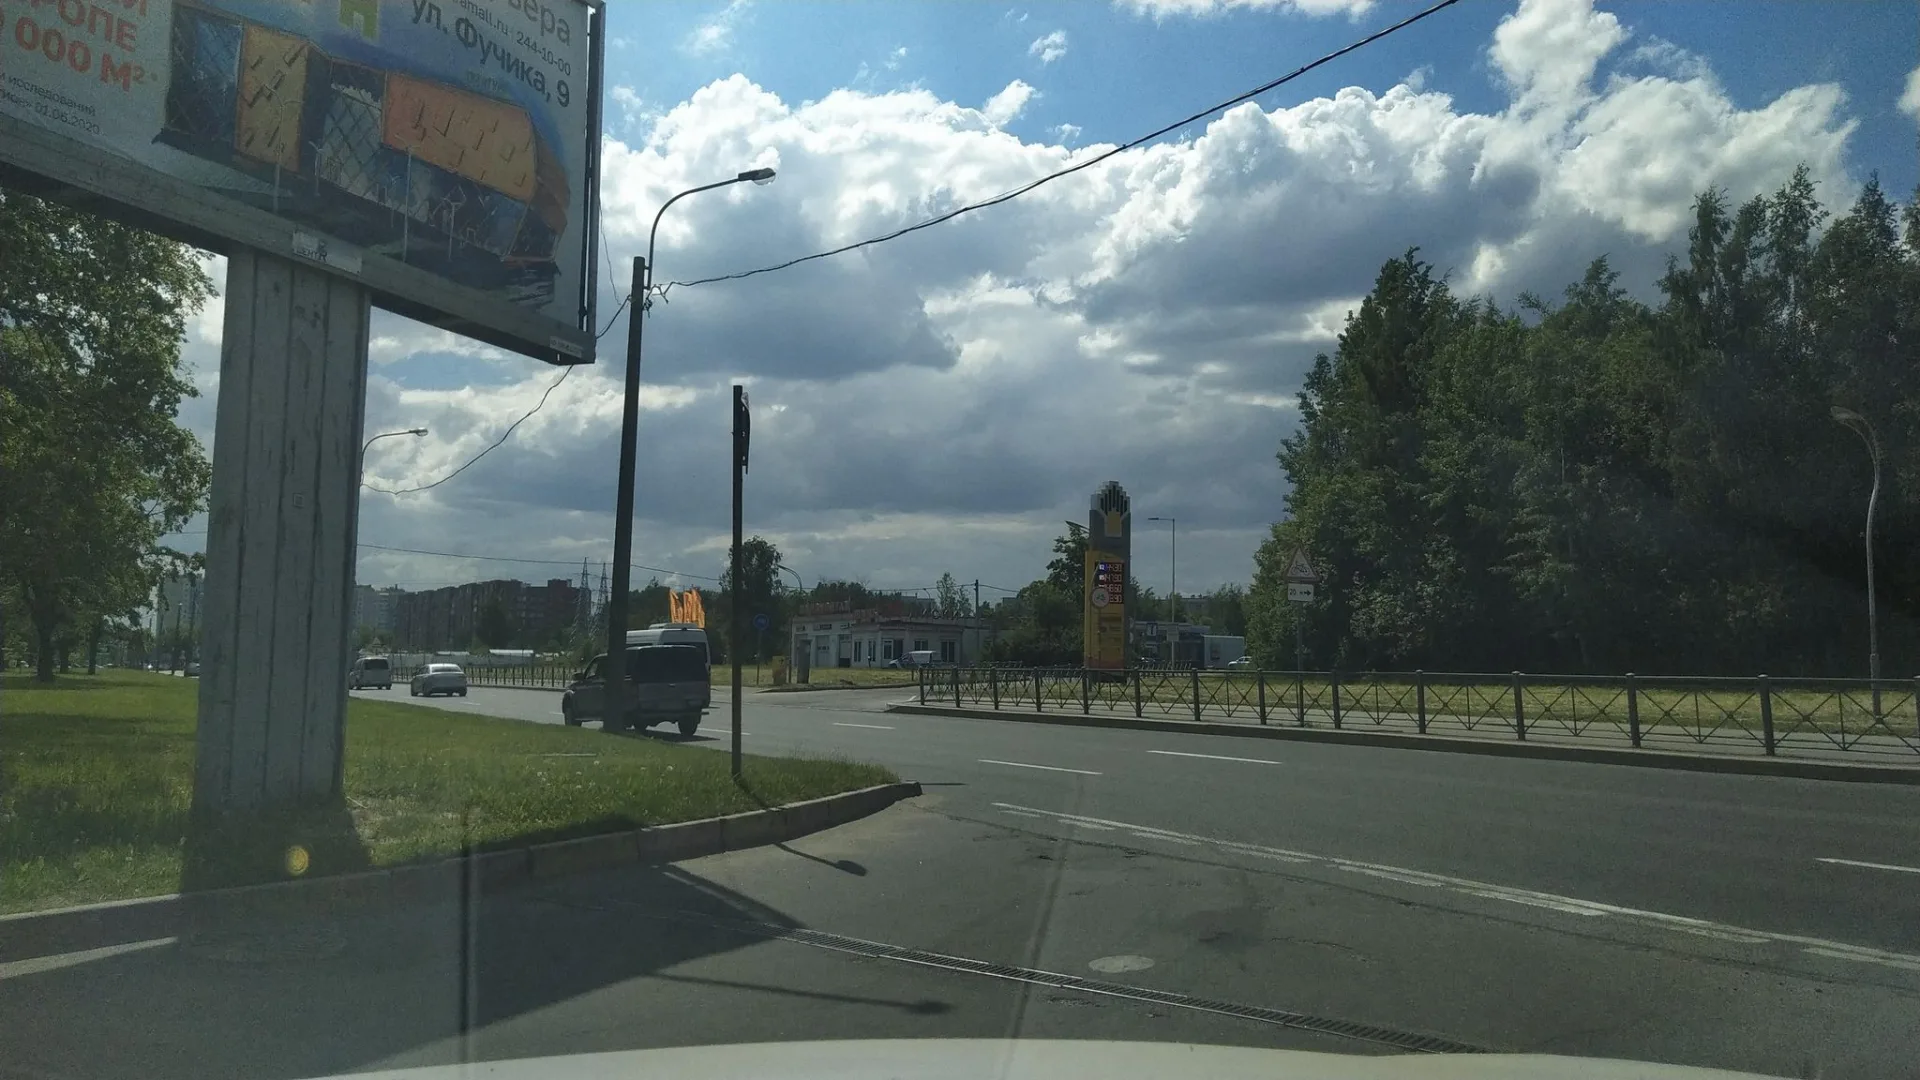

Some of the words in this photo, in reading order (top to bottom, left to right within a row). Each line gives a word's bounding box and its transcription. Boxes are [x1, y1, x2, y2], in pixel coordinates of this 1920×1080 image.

[31, 0, 137, 52] ОПЕ
[412, 0, 448, 34] ул.
[455, 17, 550, 103] Фучика,
[557, 79, 570, 108] 9
[516, 31, 571, 76] 244-10-00
